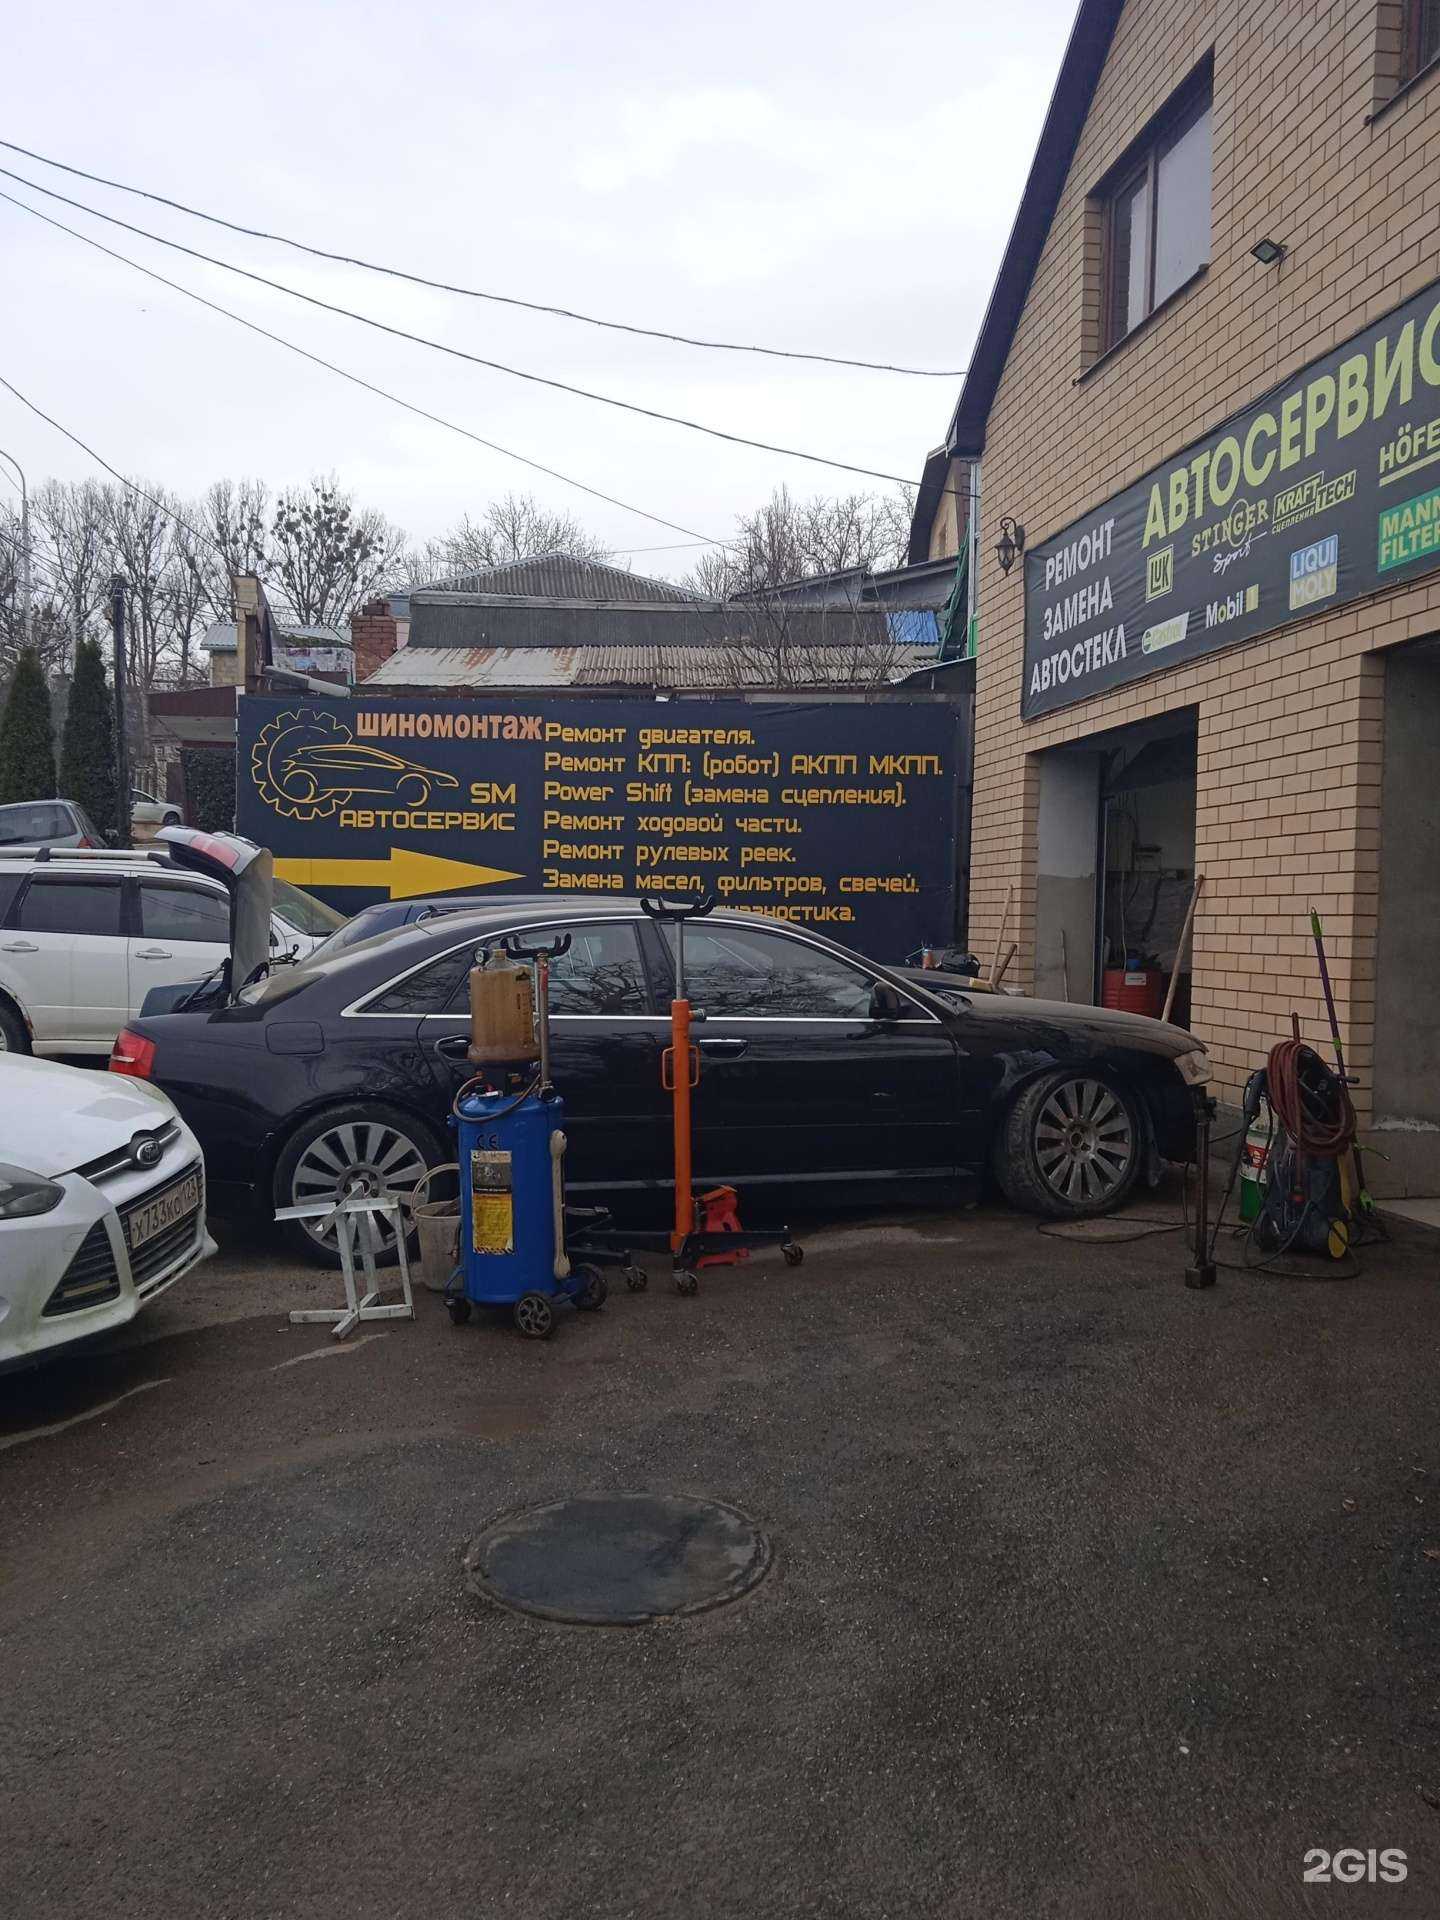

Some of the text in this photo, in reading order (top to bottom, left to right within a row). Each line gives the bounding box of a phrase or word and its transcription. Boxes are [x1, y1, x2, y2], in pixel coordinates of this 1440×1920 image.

[1142, 302, 1440, 549] АВТОСЕРВИС
[1276, 475, 1354, 517] KRAFT TECH
[1192, 499, 1269, 557] STINGER
[1045, 518, 1115, 591] РЕМОНТ
[1292, 539, 1336, 577] LIQUI
[1294, 570, 1334, 602] MOLY
[1043, 576, 1114, 641] ЗАМЕНА
[1206, 590, 1244, 628] Mobil
[1030, 623, 1127, 696] АВТОСТЕКЛ
[545, 722, 755, 750] Ремонт двигателя.
[544, 751, 943, 779] Ремонт КПП: (робот) АКПП МКПП.
[470, 782, 516, 804] SM
[544, 780, 906, 808] Power Shift (замена сцепления).
[339, 809, 516, 831] АВТОСЕРВИС
[543, 810, 802, 837] Ремонт ходовой части.
[543, 839, 796, 867] Ремонт рулевых реек.
[543, 868, 920, 897] Замена масел, фильтров, свечей.
